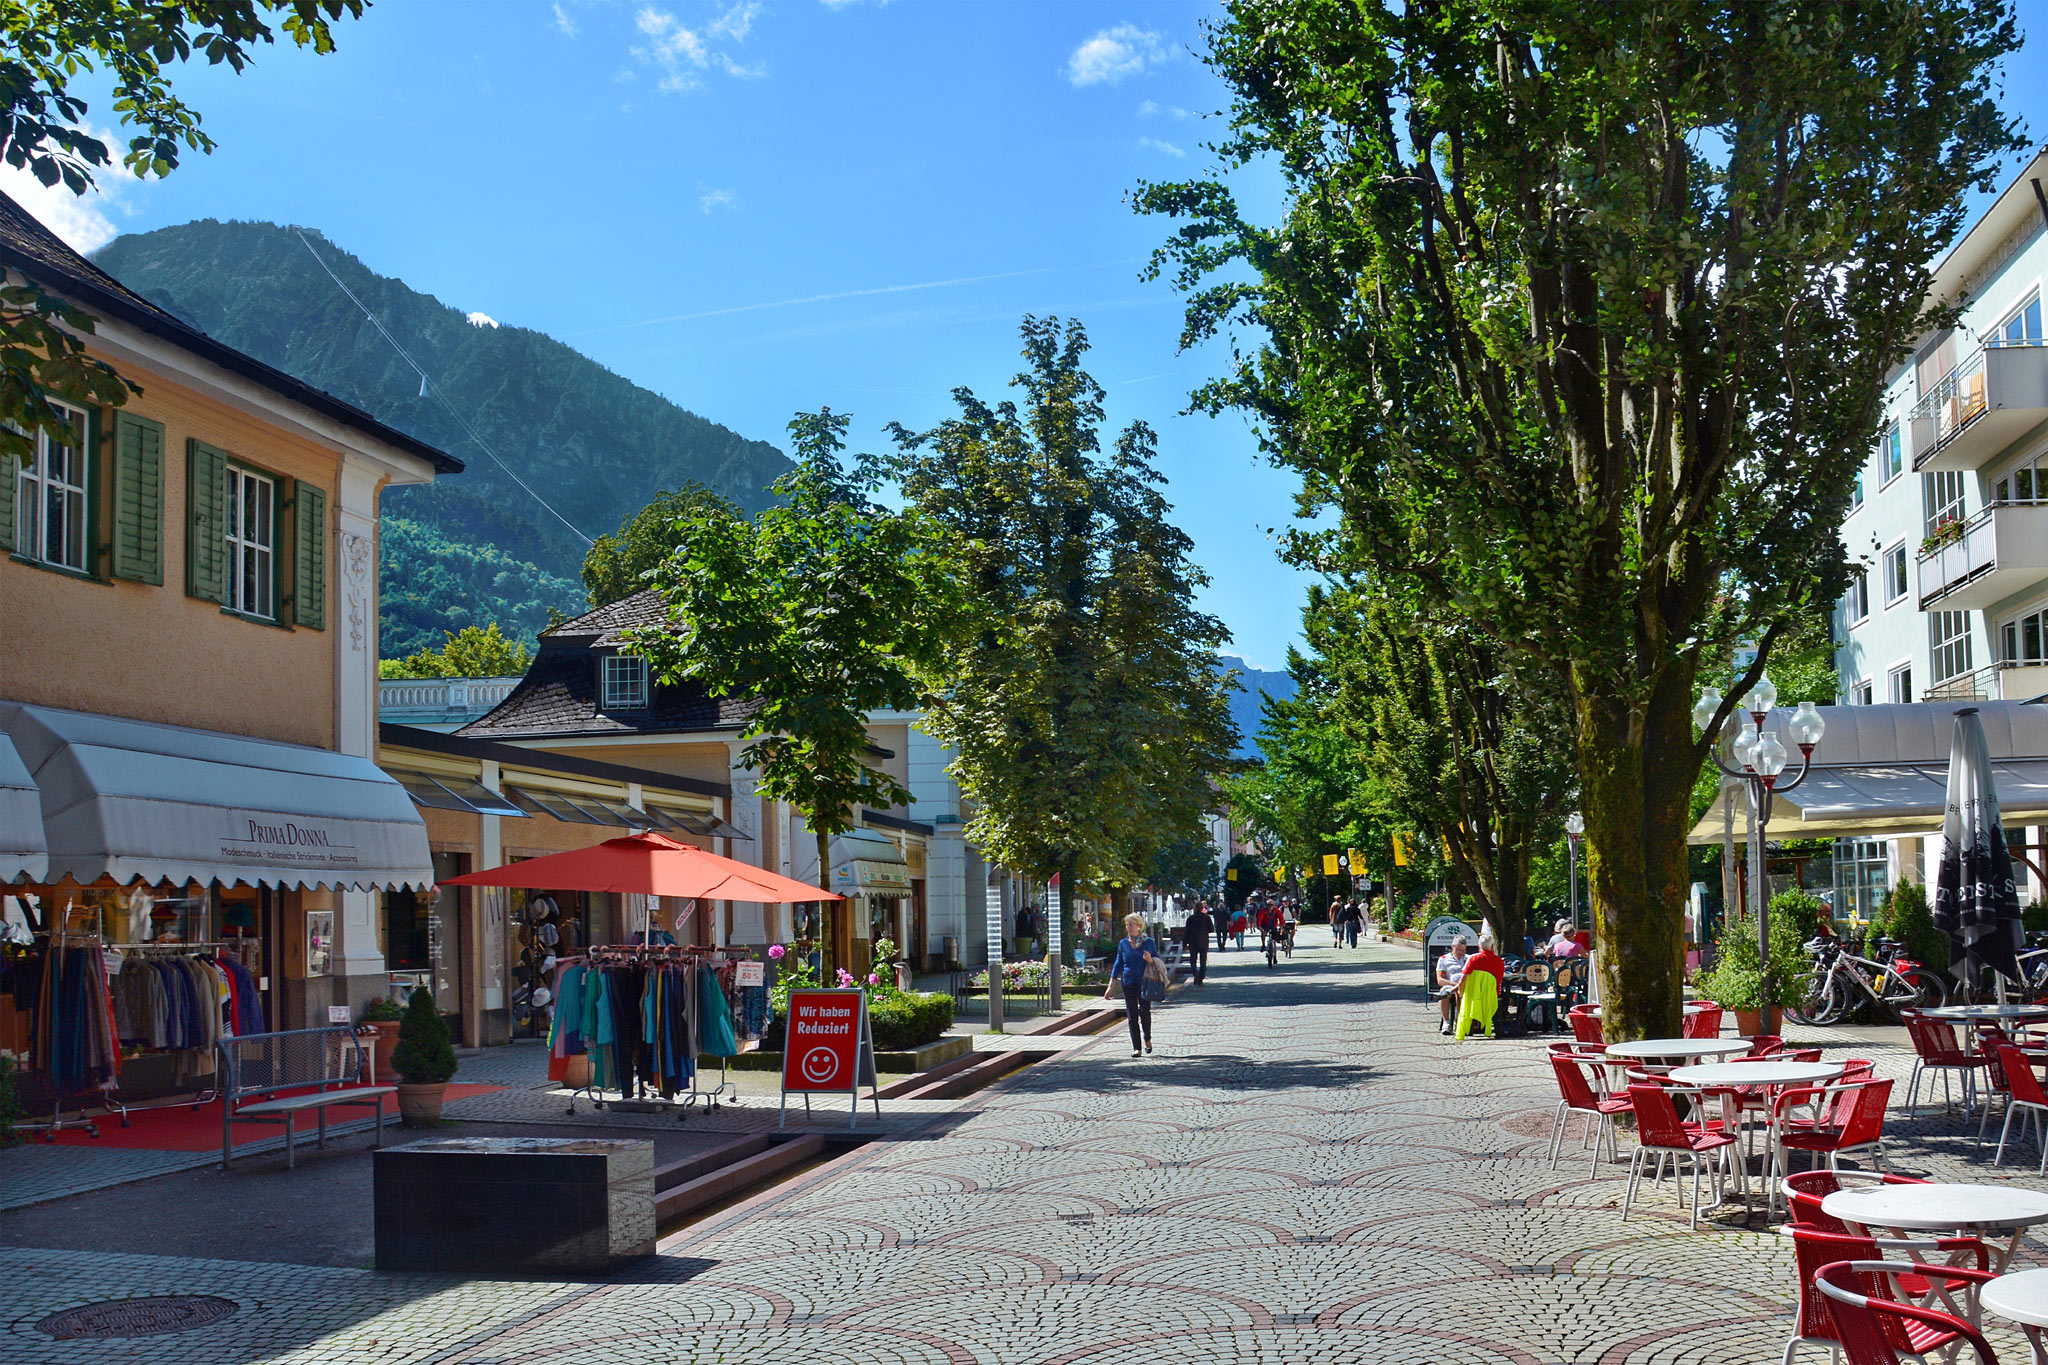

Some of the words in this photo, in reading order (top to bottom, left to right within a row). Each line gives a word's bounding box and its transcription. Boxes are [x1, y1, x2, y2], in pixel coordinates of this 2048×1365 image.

[247, 819, 287, 845] PRIMA
[286, 823, 330, 847] DONNA
[221, 846, 262, 858] Modeschmuck
[266, 850, 297, 861] Italienische
[297, 852, 326, 862] Strickmode
[742, 972, 752, 980] 50
[799, 1006, 817, 1017] Wir
[819, 1006, 851, 1017] haben
[797, 1020, 850, 1035] Reduziert
